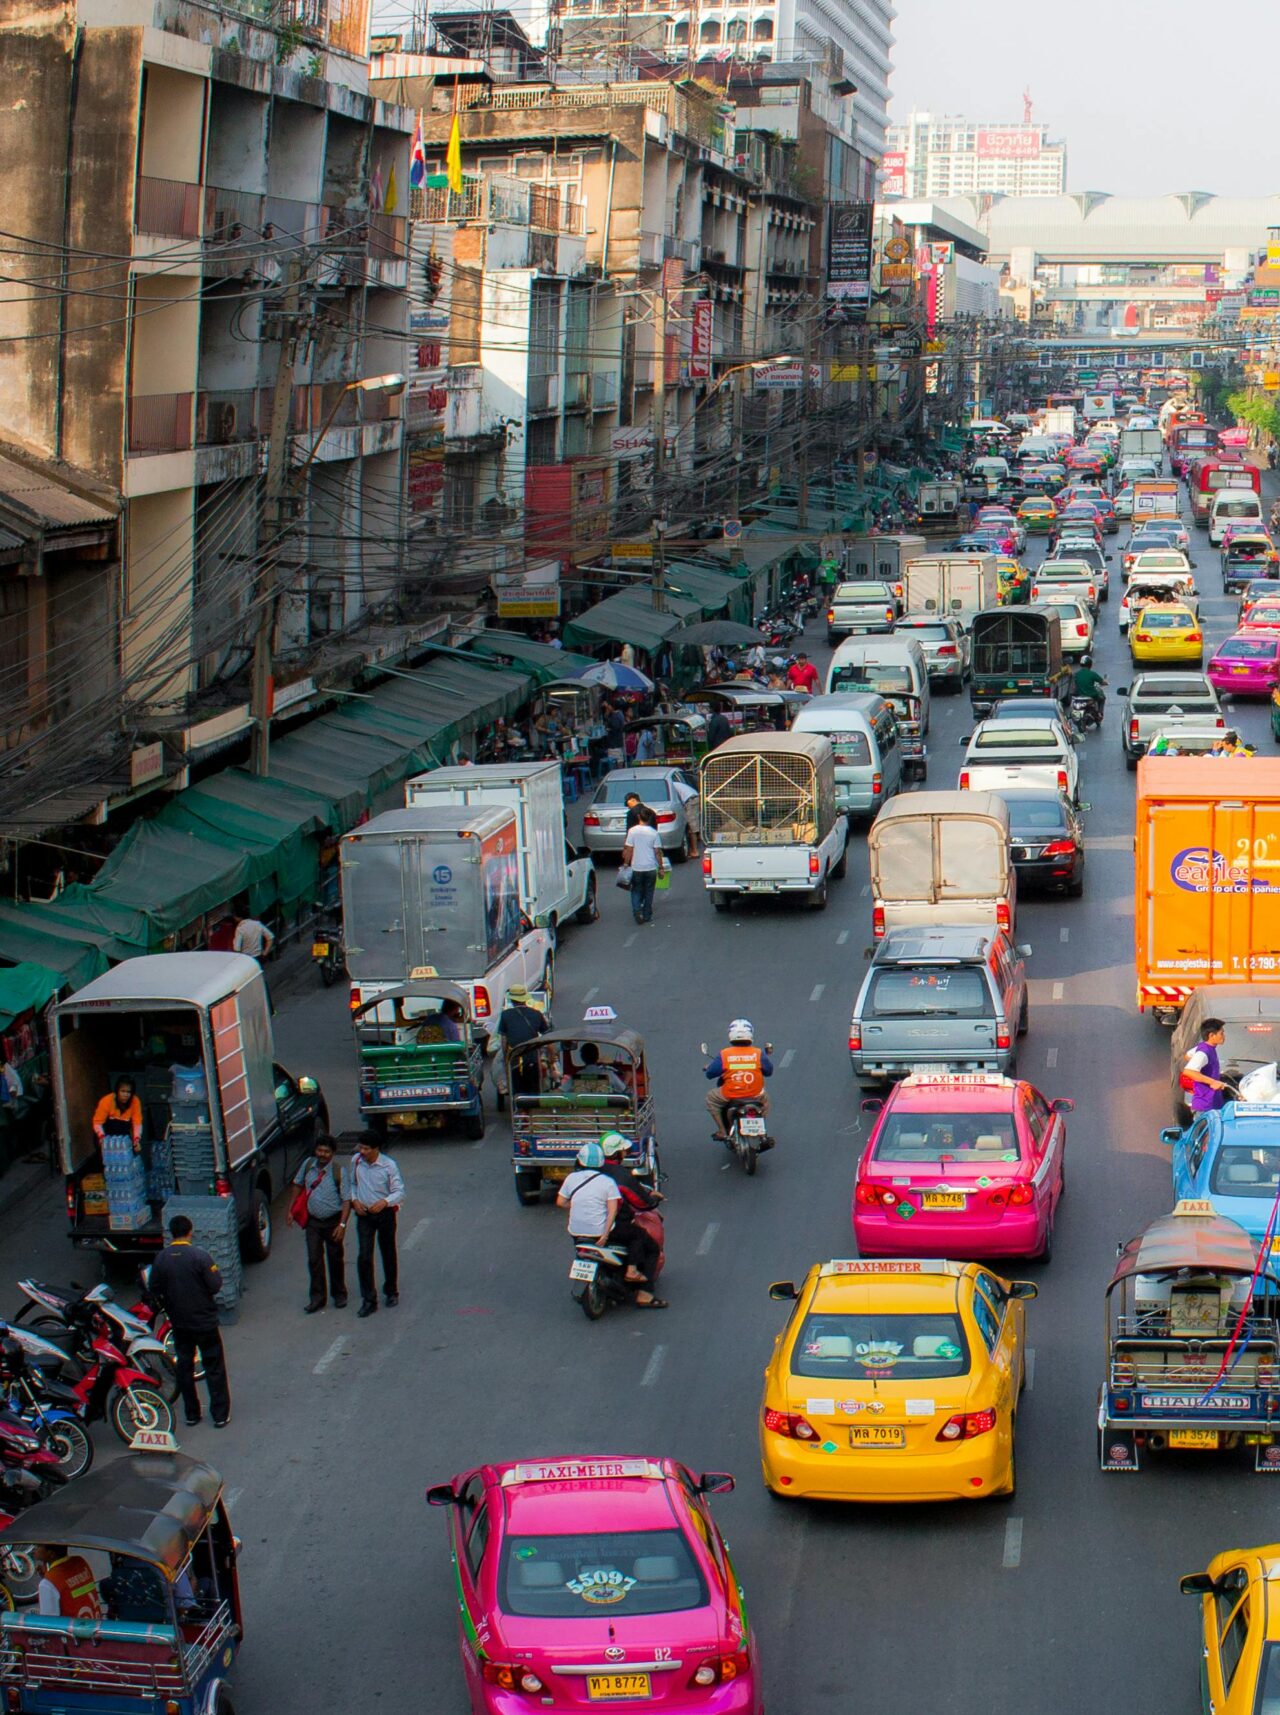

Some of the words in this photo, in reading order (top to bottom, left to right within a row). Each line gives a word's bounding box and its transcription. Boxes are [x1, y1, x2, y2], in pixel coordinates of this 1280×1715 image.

[612, 438, 676, 450] SHAP
[434, 869, 450, 879] 15
[415, 967, 432, 975] TAXI
[589, 1008, 609, 1017] TAXI
[927, 1075, 987, 1084] TAXI-METER
[384, 1086, 450, 1097] THAILAND
[1183, 1201, 1210, 1211] TAXI
[847, 1262, 922, 1272] TAXI-METER
[1148, 1396, 1245, 1408] THAILAND
[873, 1428, 900, 1439] 7019
[138, 1433, 168, 1446] TAXI
[538, 1464, 625, 1479] TAXI-METER
[565, 1570, 638, 1595] 55097
[654, 1647, 672, 1661] 82
[614, 1676, 647, 1689] 8772
